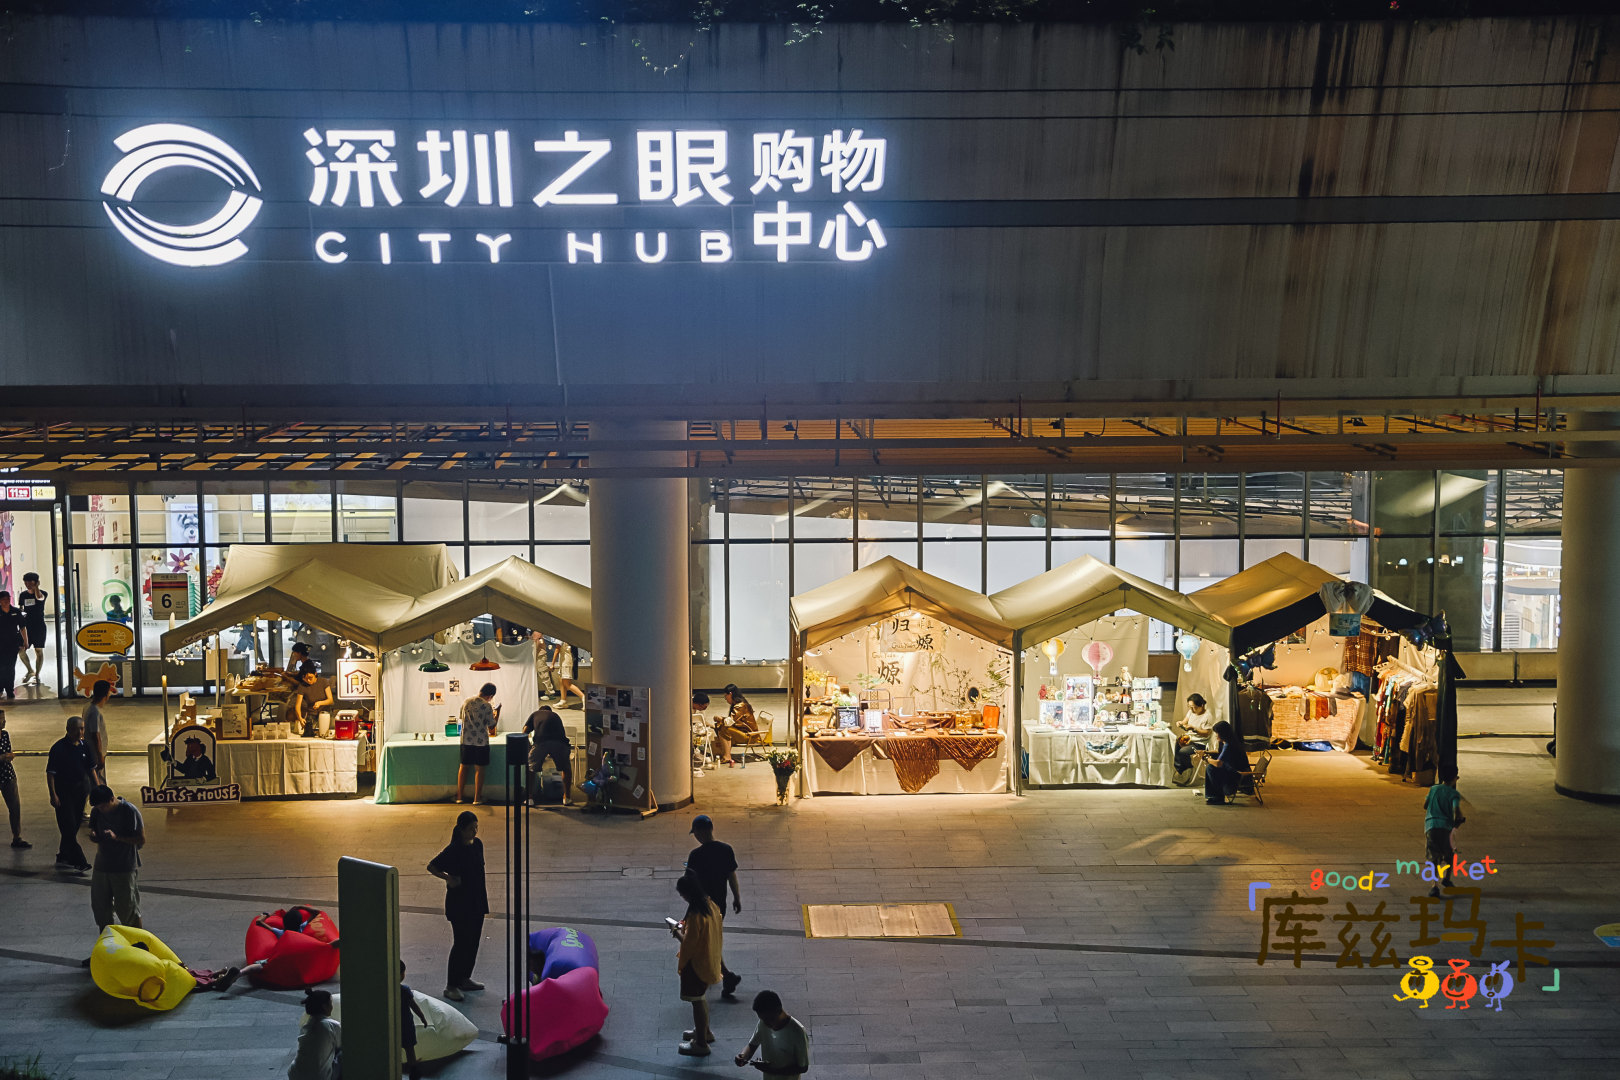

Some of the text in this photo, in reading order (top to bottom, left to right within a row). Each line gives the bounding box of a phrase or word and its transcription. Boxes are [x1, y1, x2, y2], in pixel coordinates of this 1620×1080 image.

[303, 127, 735, 208] 深圳之眼
[749, 129, 888, 195] 购物
[315, 230, 734, 265] CITY HUB
[753, 200, 888, 263] 中心
[161, 593, 172, 609] 6
